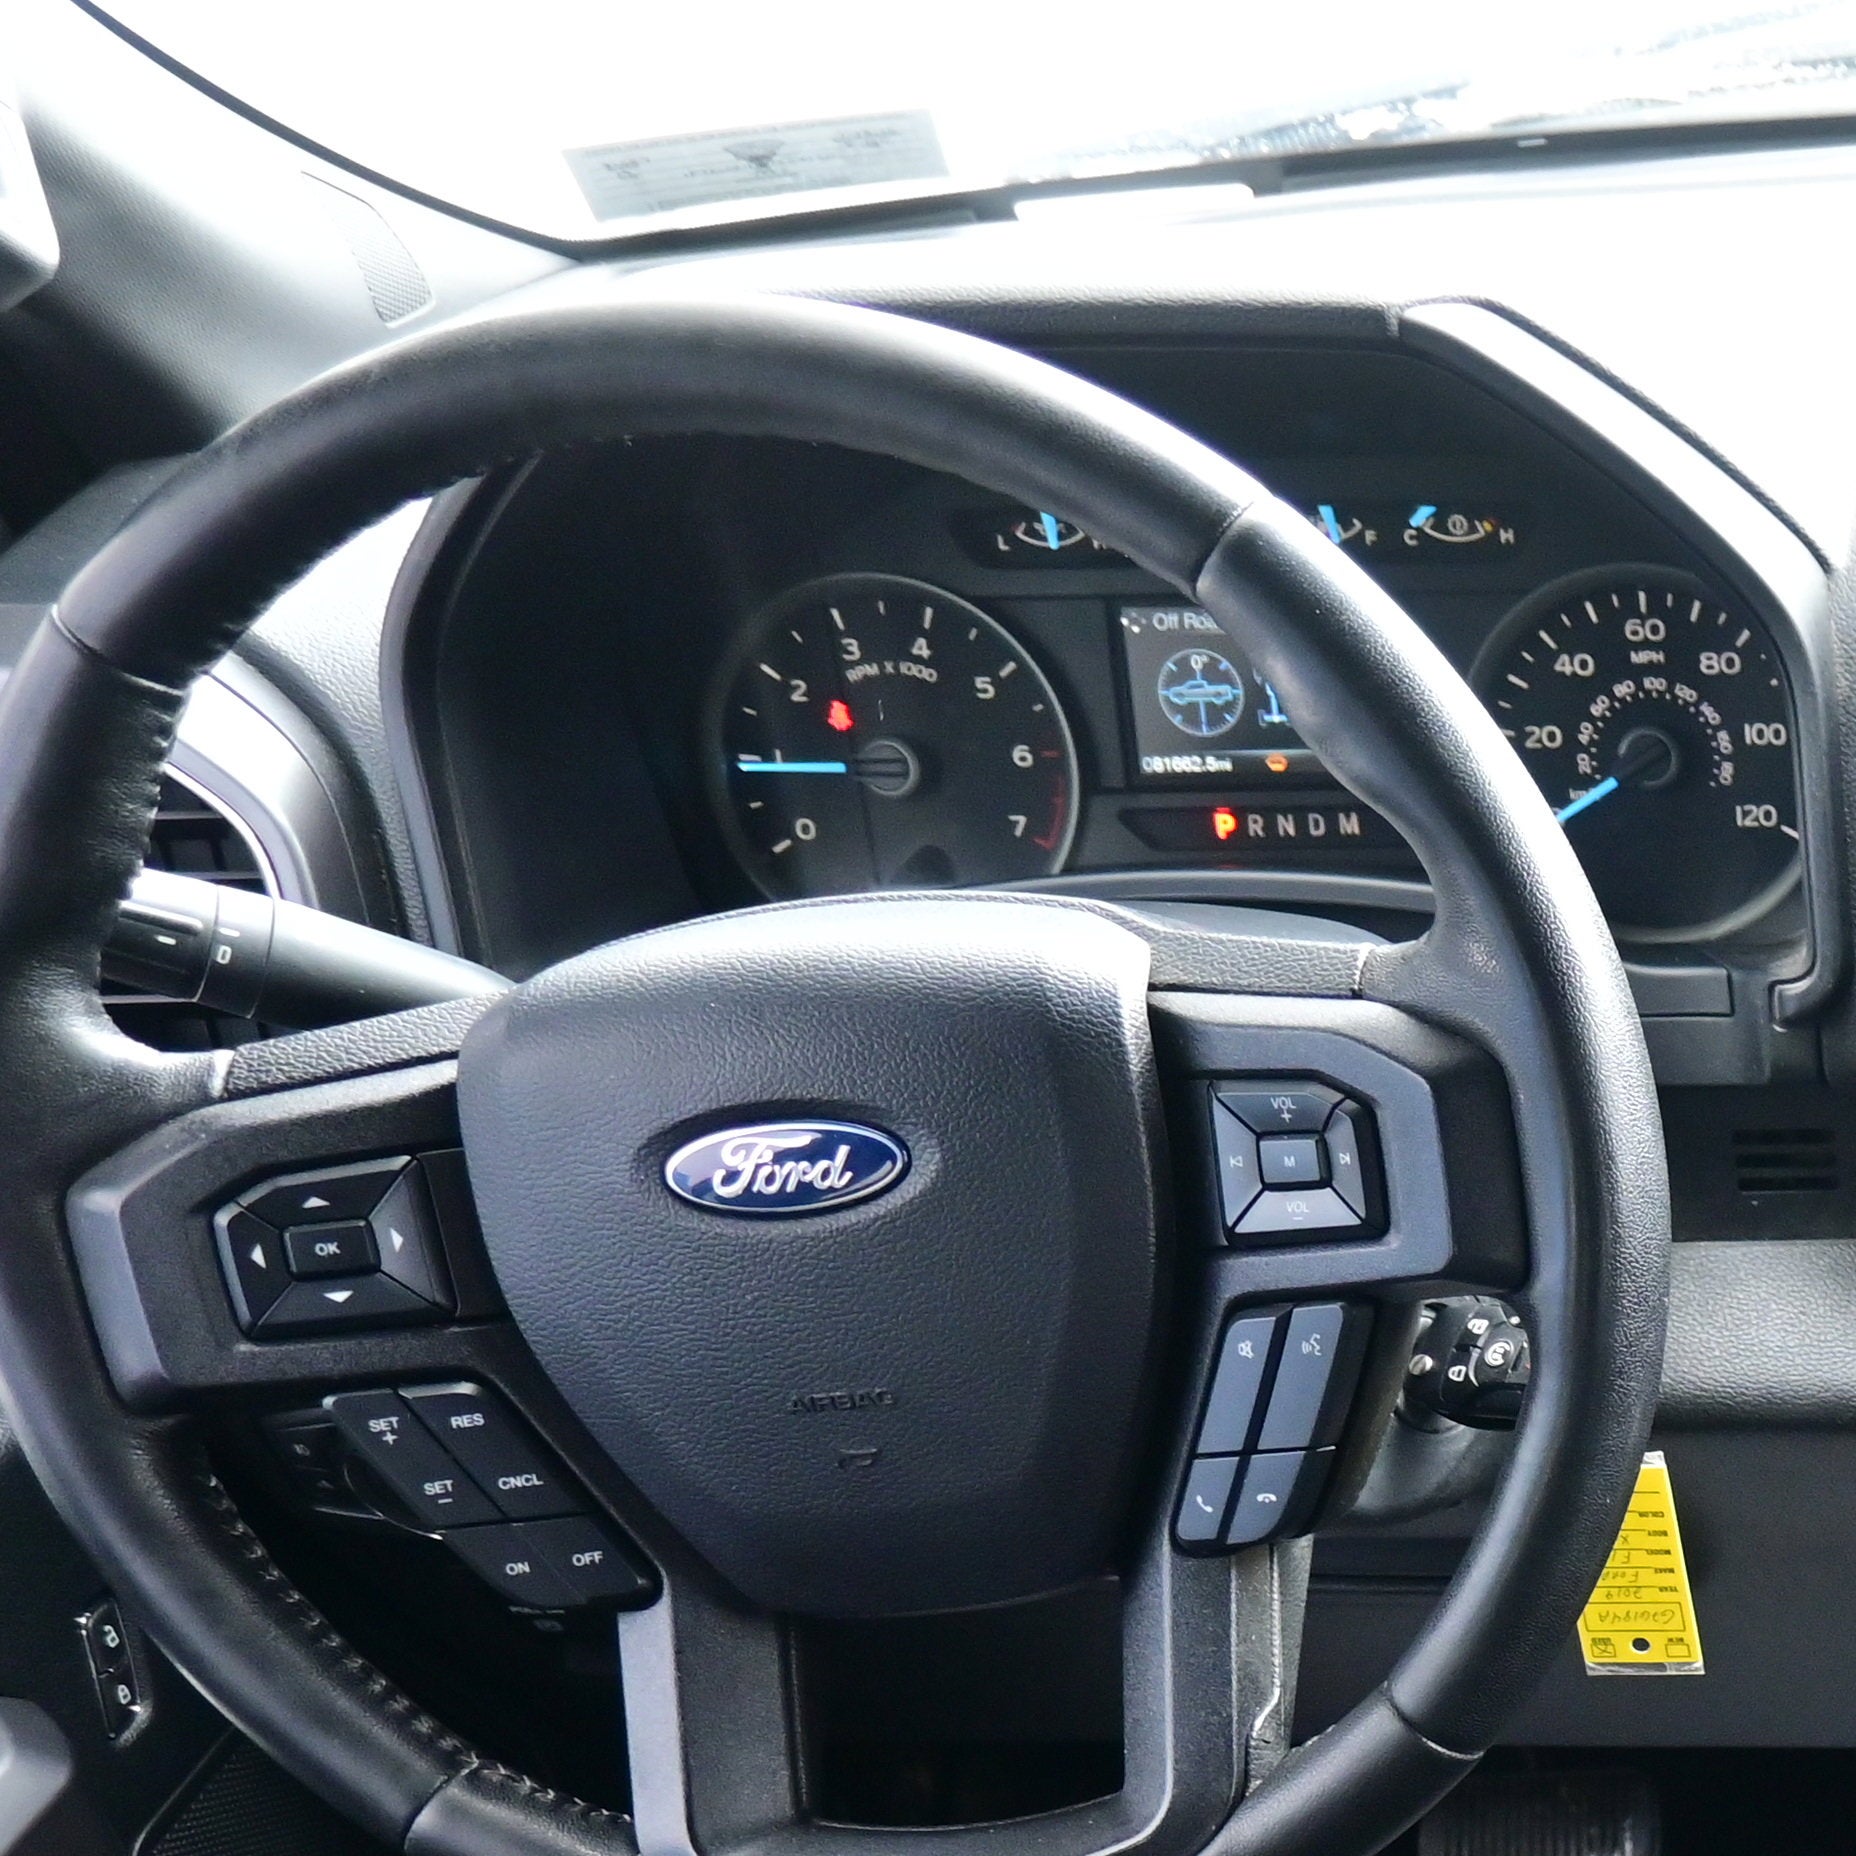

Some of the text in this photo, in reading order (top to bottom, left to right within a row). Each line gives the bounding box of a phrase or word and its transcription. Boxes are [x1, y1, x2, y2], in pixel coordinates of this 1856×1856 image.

[997, 533, 1010, 551] L
[1364, 530, 1378, 546] F
[1403, 529, 1418, 546] C
[1500, 527, 1514, 545] H
[1151, 611, 1219, 631] Off Roa
[1624, 618, 1666, 642] 60
[841, 638, 862, 661] 3
[912, 637, 931, 659] 4
[1630, 650, 1665, 664] MPH
[846, 661, 880, 683] RPM
[899, 661, 938, 684] 1000
[1554, 653, 1595, 676] 40
[1699, 651, 1741, 675] 80
[789, 680, 809, 702] 2
[974, 676, 995, 699] 5
[1612, 679, 1636, 698] 80
[1642, 676, 1668, 691] 100
[1674, 682, 1698, 702] 120
[1589, 694, 1611, 718] 60
[1524, 725, 1563, 749] 20
[1577, 721, 1595, 746] 40
[1743, 722, 1788, 746] 100
[1012, 745, 1034, 768] 6
[1576, 753, 1592, 776] 20
[1008, 815, 1027, 838] 7
[1212, 811, 1361, 840] P R N D M
[1735, 804, 1778, 828] 120
[795, 818, 816, 840] 0
[1270, 1097, 1297, 1109] VOL
[712, 1135, 854, 1198] Ford
[1283, 1156, 1296, 1167] M
[1286, 1200, 1310, 1212] VOL
[314, 1239, 341, 1258] OK
[368, 1416, 400, 1432] SET
[450, 1413, 485, 1430] RES
[423, 1479, 454, 1496] SET
[498, 1473, 544, 1491] CNCL
[505, 1561, 531, 1577] ON
[572, 1551, 604, 1568] OFF
